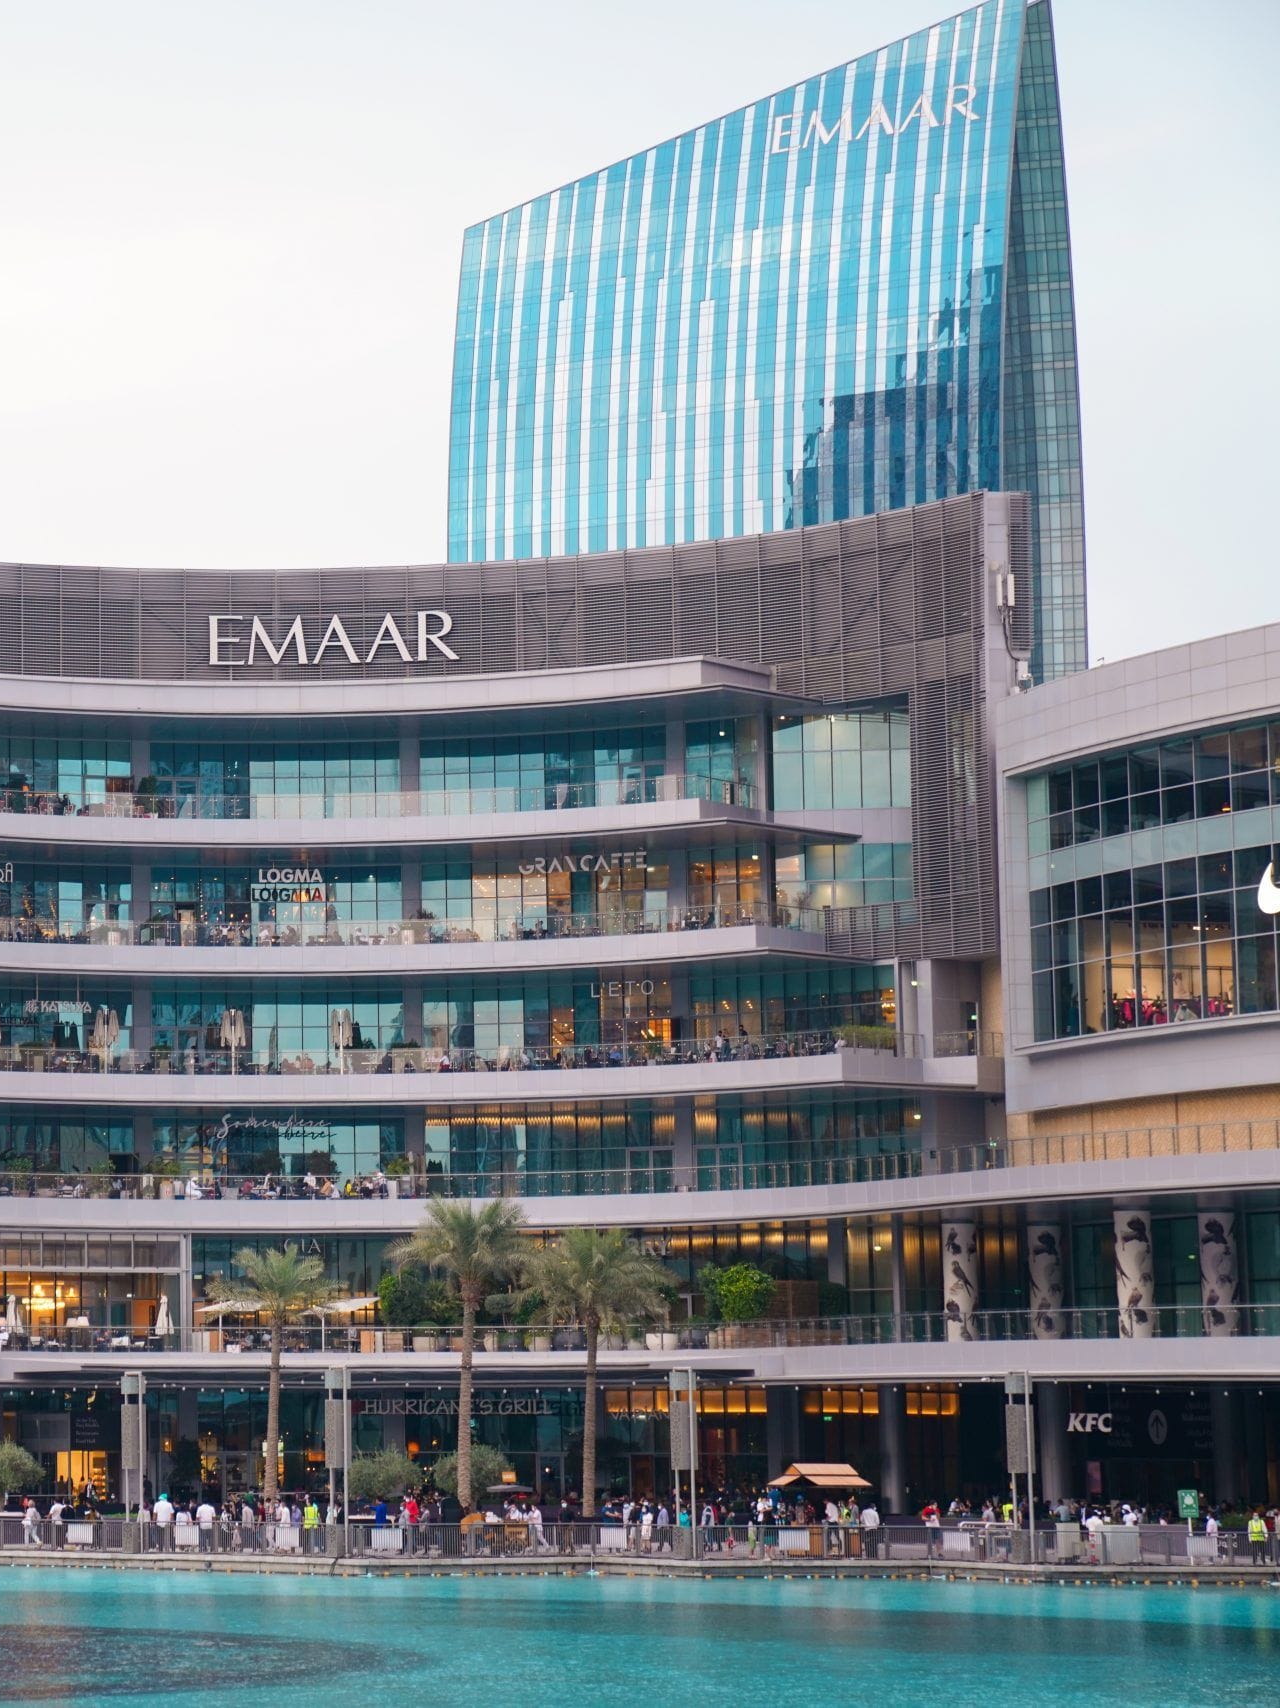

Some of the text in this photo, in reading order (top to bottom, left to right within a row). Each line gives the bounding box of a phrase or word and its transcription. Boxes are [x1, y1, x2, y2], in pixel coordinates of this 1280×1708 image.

[770, 84, 981, 154] EMAAR
[208, 610, 461, 666] EMAAR
[258, 868, 323, 883] LOGMA
[590, 979, 654, 998] L'ETO
[363, 1400, 553, 1415] HURRICAN'S GRILL
[1067, 1413, 1112, 1432] KFC
